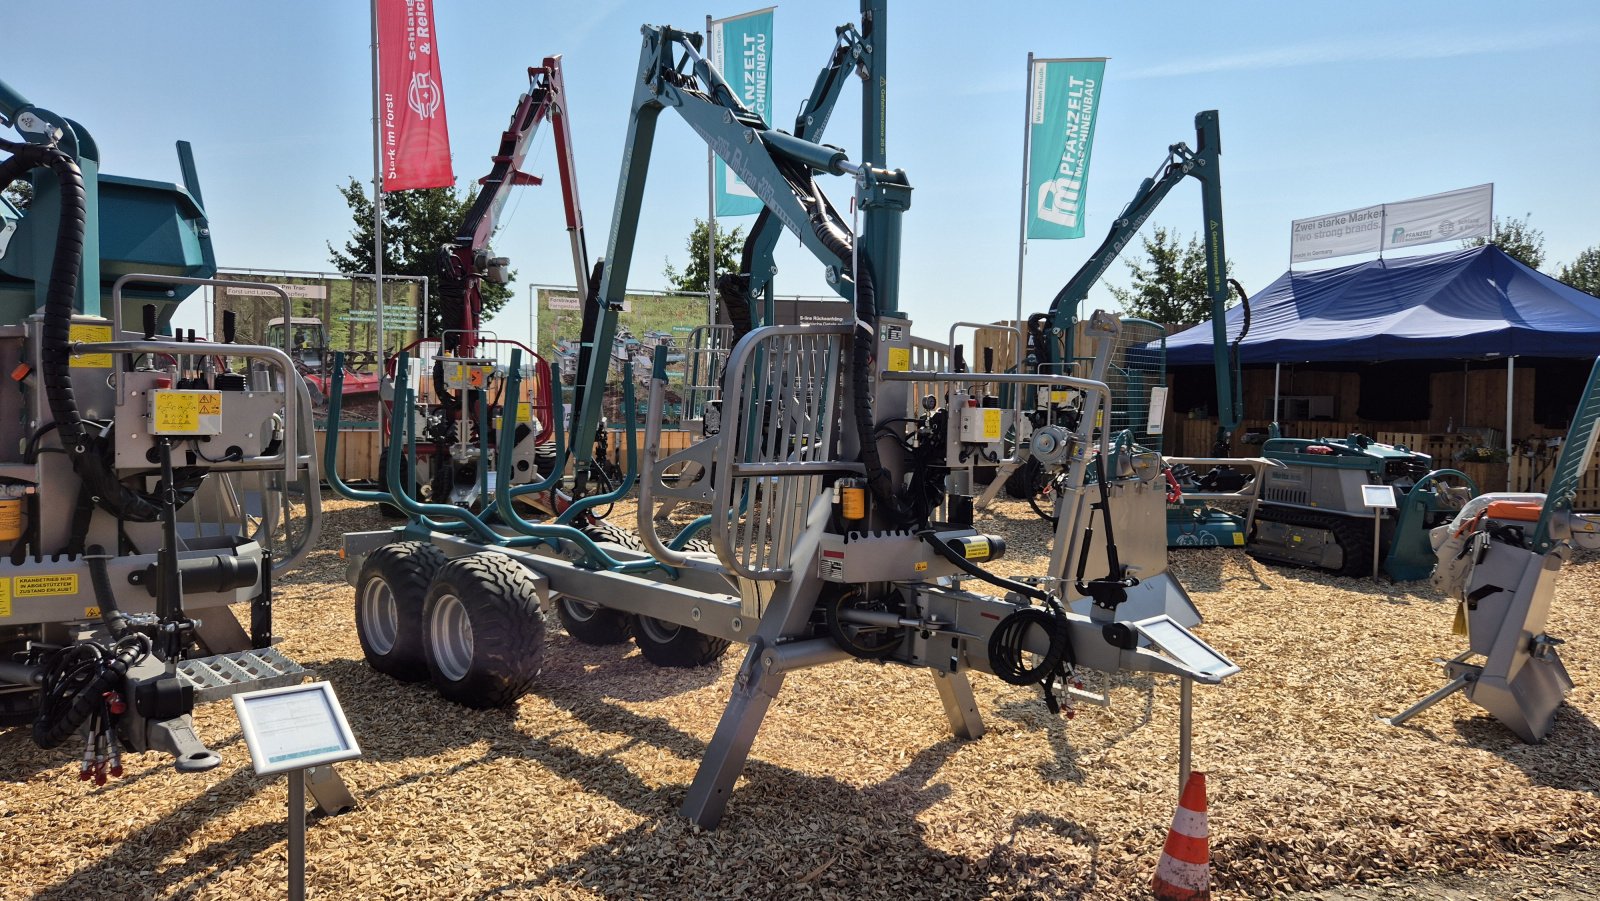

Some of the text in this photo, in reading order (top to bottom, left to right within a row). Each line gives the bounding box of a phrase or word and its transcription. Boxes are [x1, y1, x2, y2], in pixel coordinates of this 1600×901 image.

[420, 43, 431, 54] &
[743, 33, 756, 114] ANZELT
[756, 34, 766, 115] CHINENBAU
[385, 93, 397, 180] Stark im Forst!
[1060, 76, 1084, 176] PFANZELT
[1074, 79, 1096, 177] MASCHINENBAU
[1294, 222, 1316, 233] Zwei
[1318, 216, 1346, 229] starke
[1294, 220, 1381, 243] Two strong brands.
